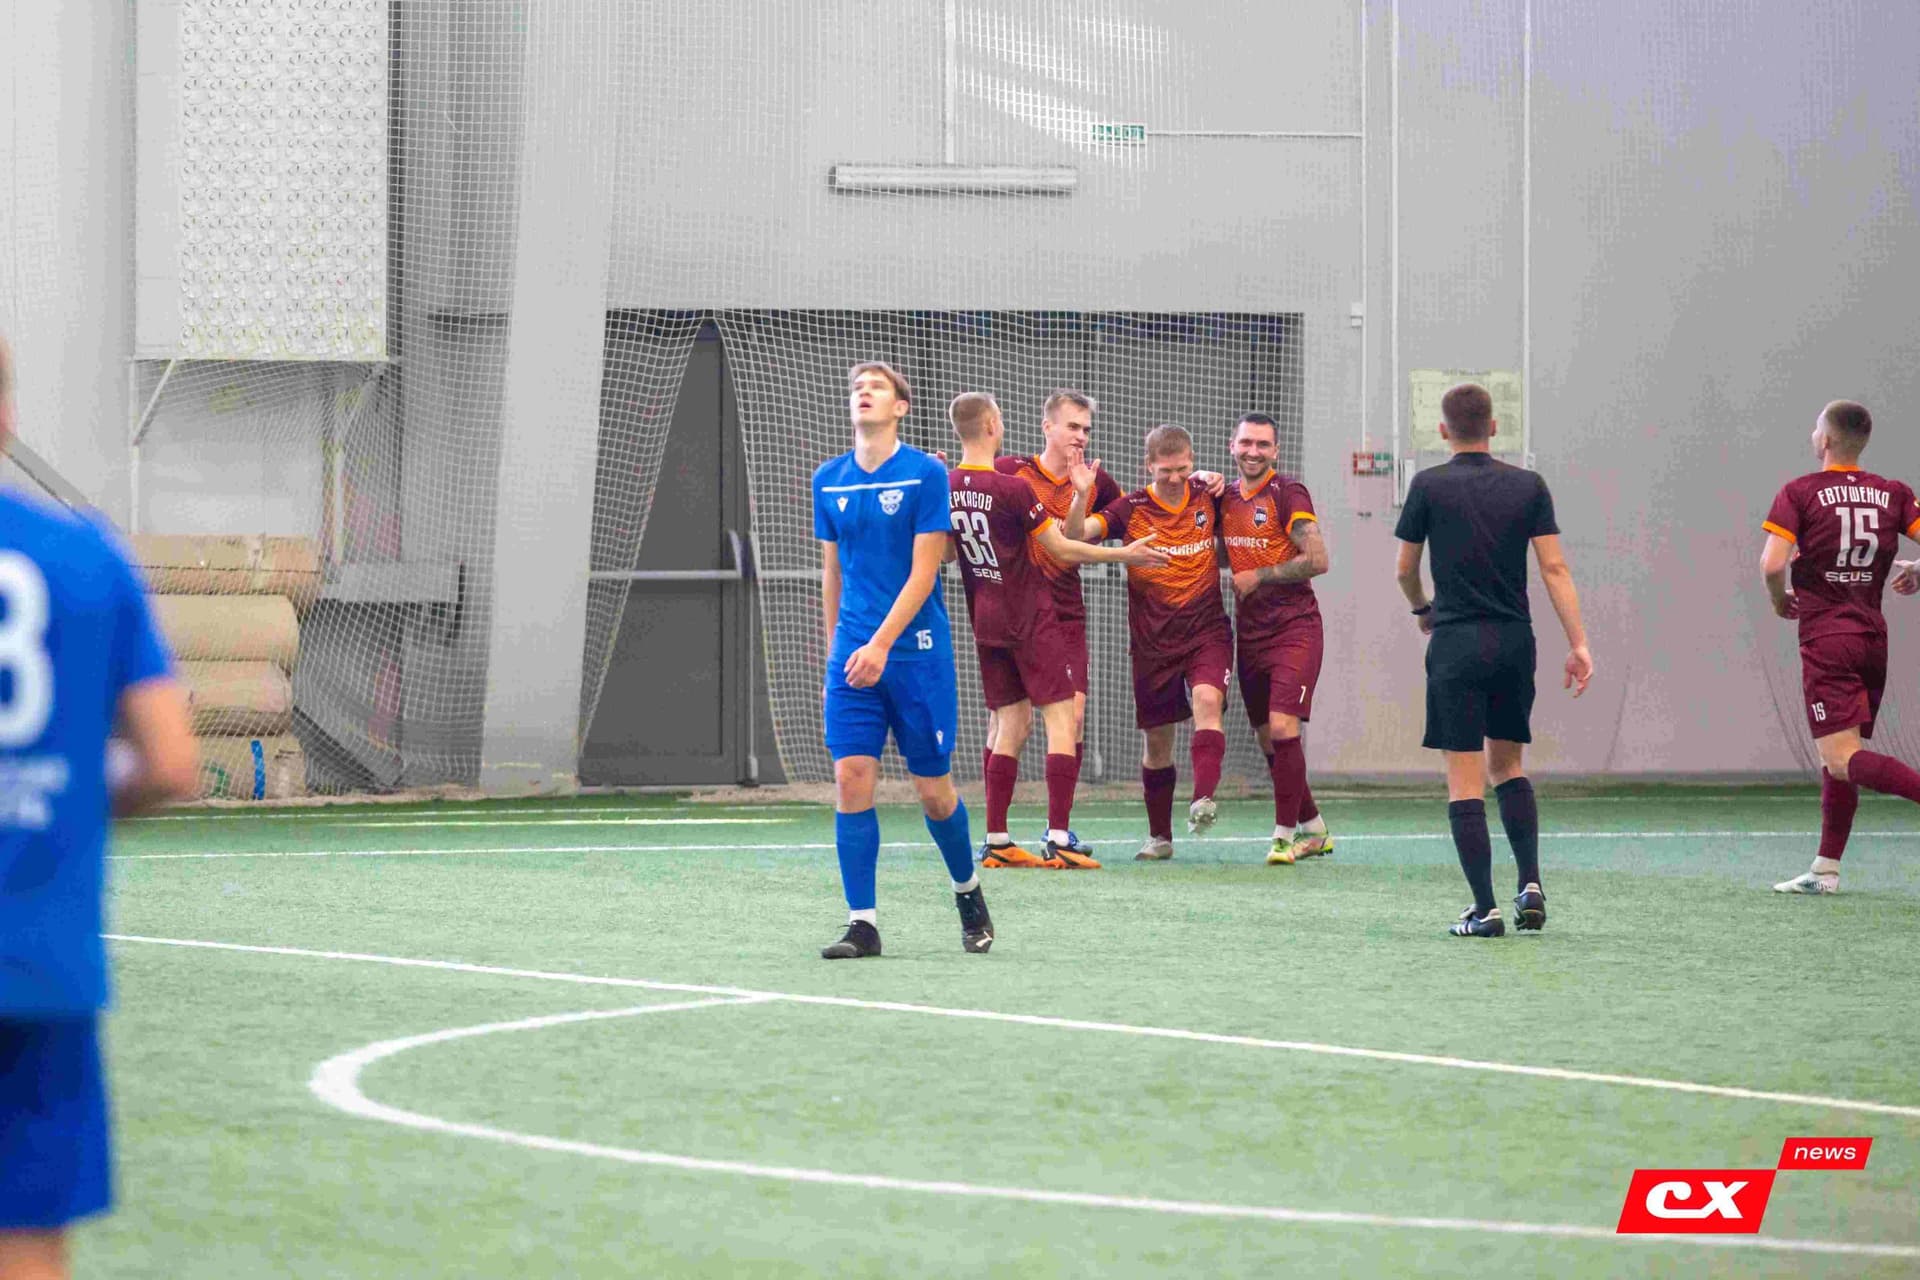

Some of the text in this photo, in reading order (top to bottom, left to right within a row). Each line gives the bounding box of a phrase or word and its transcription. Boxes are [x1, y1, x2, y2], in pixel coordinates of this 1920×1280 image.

[1817, 486, 1890, 508] ЕВТУШЕНКО
[950, 511, 999, 567] 33
[1835, 507, 1880, 567] 15
[1825, 571, 1873, 583] SEUS
[915, 629, 934, 650] 15
[1811, 702, 1826, 722] 15
